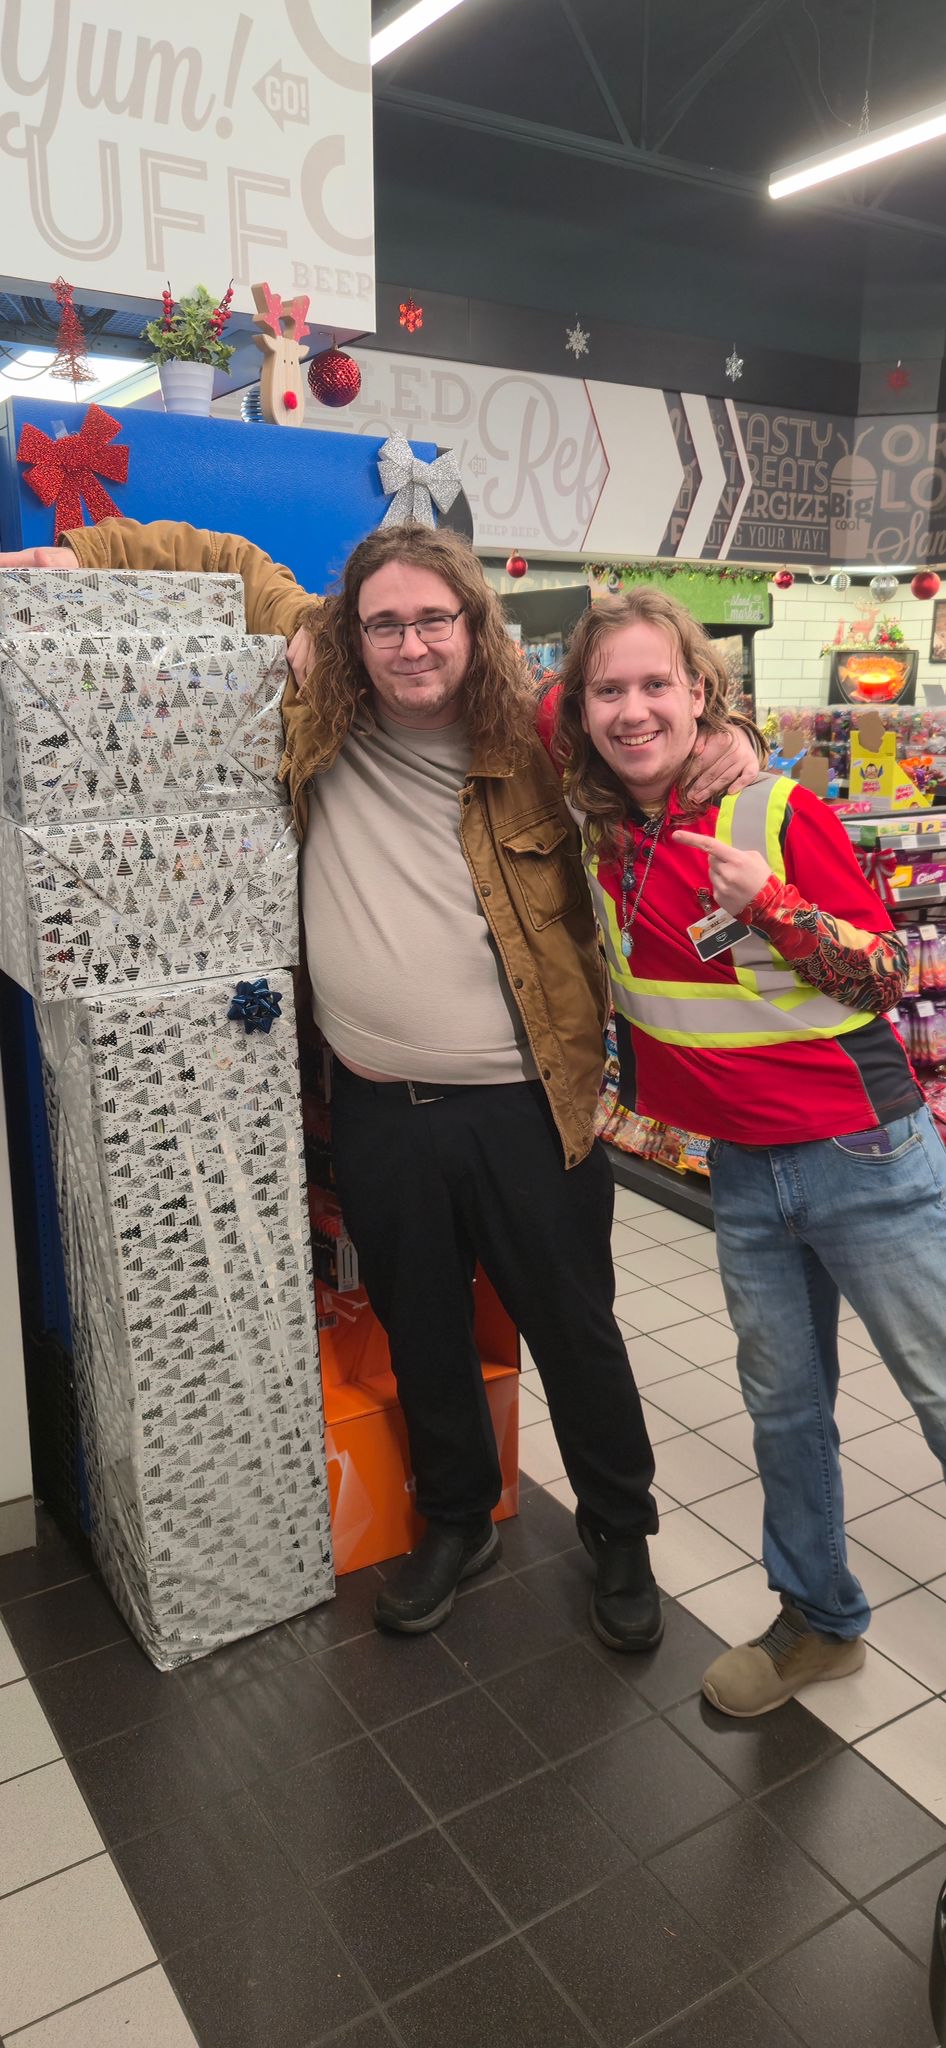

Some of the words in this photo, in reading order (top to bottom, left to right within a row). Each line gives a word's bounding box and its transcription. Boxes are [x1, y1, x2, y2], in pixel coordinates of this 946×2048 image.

[264, 75, 308, 117] GO!
[291, 261, 372, 299] BEEP
[749, 526, 785, 548] YOUR
[791, 529, 825, 550] WAY!
